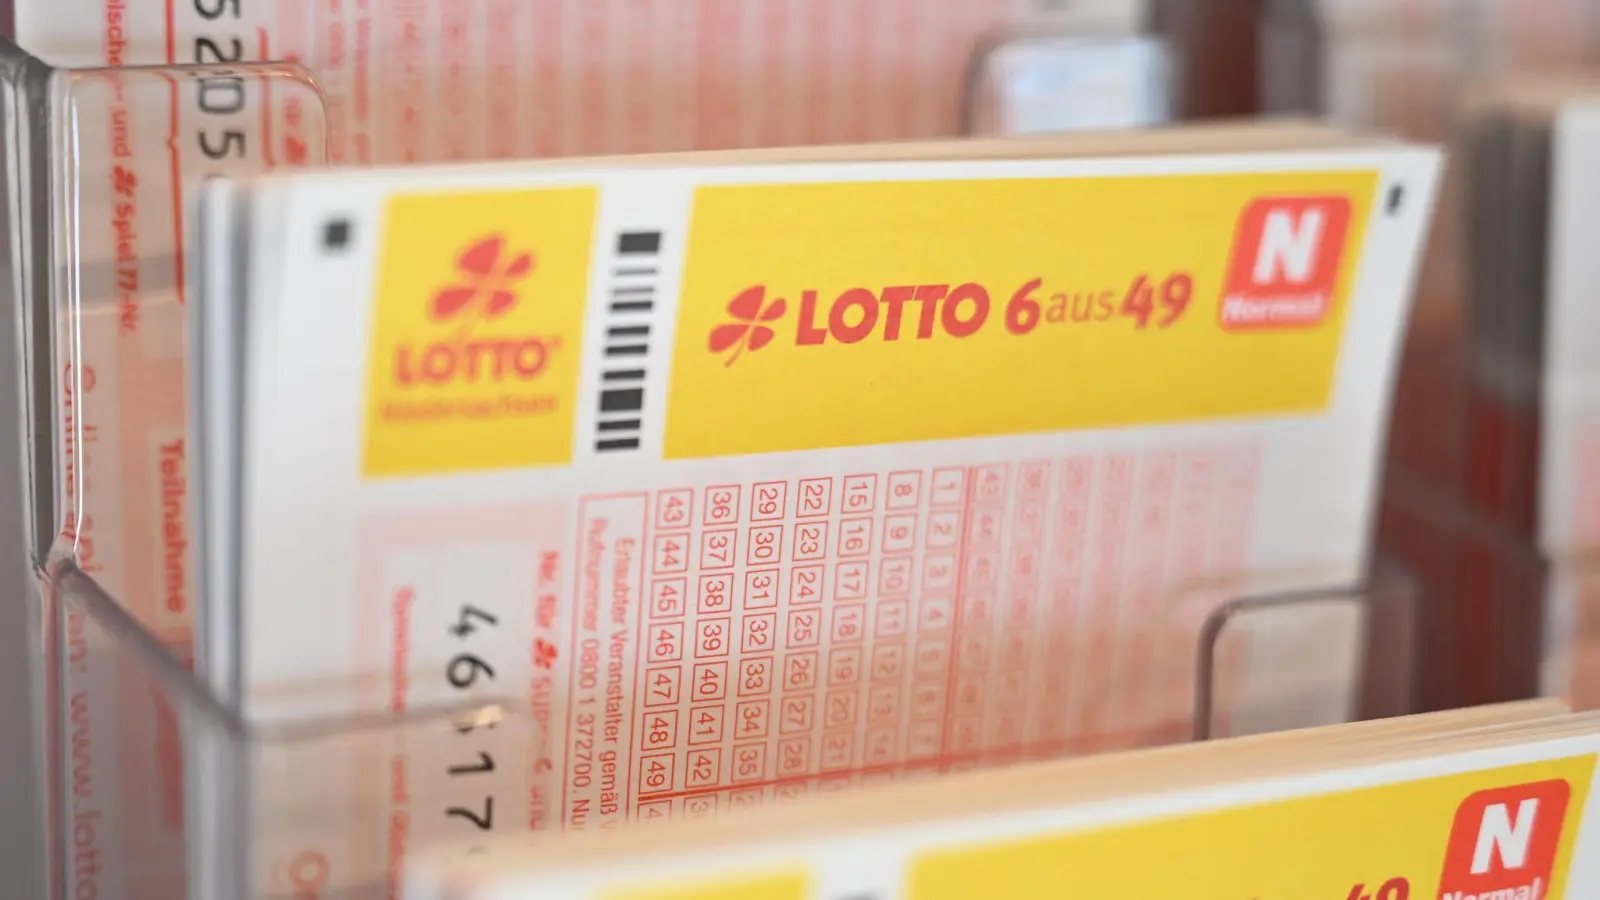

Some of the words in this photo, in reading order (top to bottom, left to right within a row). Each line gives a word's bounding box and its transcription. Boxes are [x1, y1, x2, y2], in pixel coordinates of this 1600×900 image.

[112, 203, 137, 264] Spiel
[1253, 209, 1323, 286] N
[795, 280, 990, 347] LOTTO
[1222, 290, 1324, 324] Normal
[393, 334, 552, 388] LOTTO
[804, 484, 824, 512] 22
[849, 482, 868, 508] 15
[894, 484, 912, 498] 8
[939, 482, 955, 491] 1
[663, 496, 684, 523] 43
[711, 492, 731, 519] 36
[758, 488, 778, 515] 29
[159, 438, 188, 613] Teilnahme
[845, 525, 863, 550] 16
[890, 528, 908, 541] 9
[933, 523, 952, 536] 2
[661, 540, 680, 568] 44
[709, 536, 728, 562] 37
[755, 532, 774, 559] 30
[800, 528, 820, 555] 23
[611, 538, 635, 625] Erlaubter
[842, 569, 860, 593] 17
[885, 564, 904, 587] 10
[929, 566, 947, 578] 3
[658, 585, 678, 612] 45
[705, 580, 725, 607] 38
[752, 576, 771, 600] 31
[797, 572, 816, 599] 24
[794, 615, 813, 642] 25
[838, 612, 856, 637] 18
[882, 608, 900, 628] 11
[655, 629, 674, 656] 46
[702, 625, 722, 652] 39
[750, 620, 768, 646] 32
[578, 638, 599, 690] 0800
[791, 659, 809, 685] 26
[835, 656, 853, 680] 19
[878, 651, 896, 674] 12
[604, 629, 629, 745] Veranstalter
[654, 674, 671, 699] 47
[700, 668, 718, 695] 40
[745, 663, 764, 690] 33
[787, 701, 806, 726] 27
[831, 697, 849, 722] 20
[874, 693, 891, 716] 13
[650, 717, 668, 743] 48
[696, 712, 714, 737] 41
[743, 706, 761, 732] 34
[573, 713, 595, 794] 372700.
[738, 749, 757, 776] 35
[783, 743, 802, 769] 28
[828, 739, 846, 762] 21
[646, 761, 665, 786] 49
[693, 755, 712, 781] 42
[598, 750, 619, 815] gemäß
[1470, 797, 1540, 875] N
